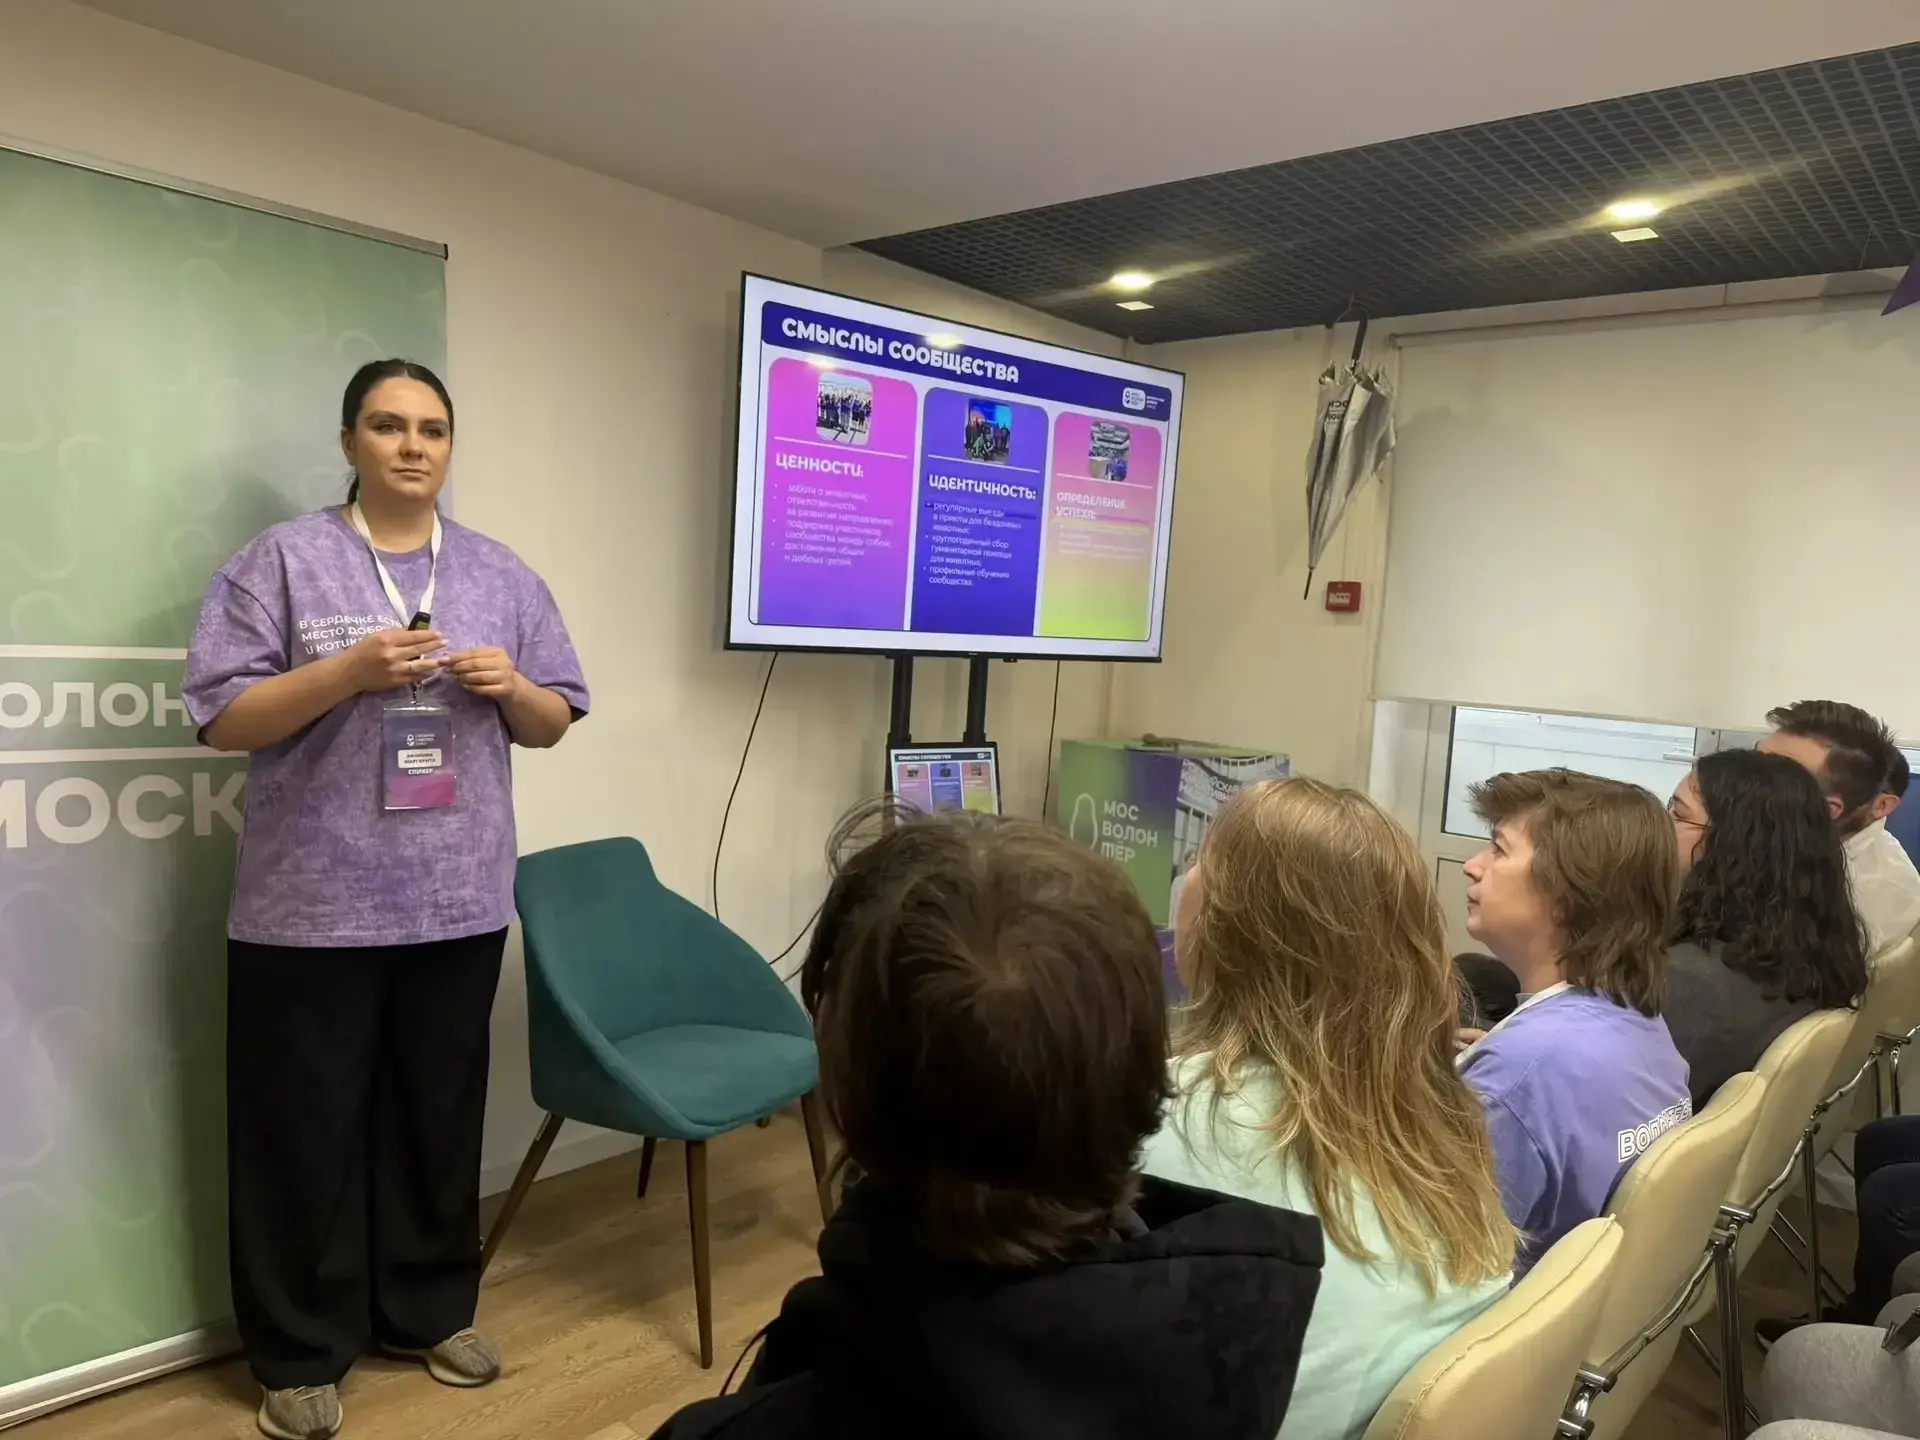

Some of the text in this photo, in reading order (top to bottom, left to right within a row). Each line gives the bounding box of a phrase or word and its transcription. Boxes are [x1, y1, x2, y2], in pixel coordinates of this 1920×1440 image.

[782, 317, 1019, 383] СМЫСЛЫ СООБЩЕСТВА
[776, 452, 864, 478] ЦЕННОСТИ:
[928, 474, 1037, 500] ИДЕНТИЧНОСТЬ:
[299, 620, 308, 629] В
[311, 614, 374, 629] СЕРДЕЧКЕ
[301, 625, 386, 642] МЕСТО ДОБР
[305, 638, 362, 655] И КОТИК
[0, 682, 192, 729] ОЛОН
[0, 771, 248, 848] ОСК
[1104, 800, 1139, 821] МОС
[1102, 820, 1158, 848] ВОЛОН
